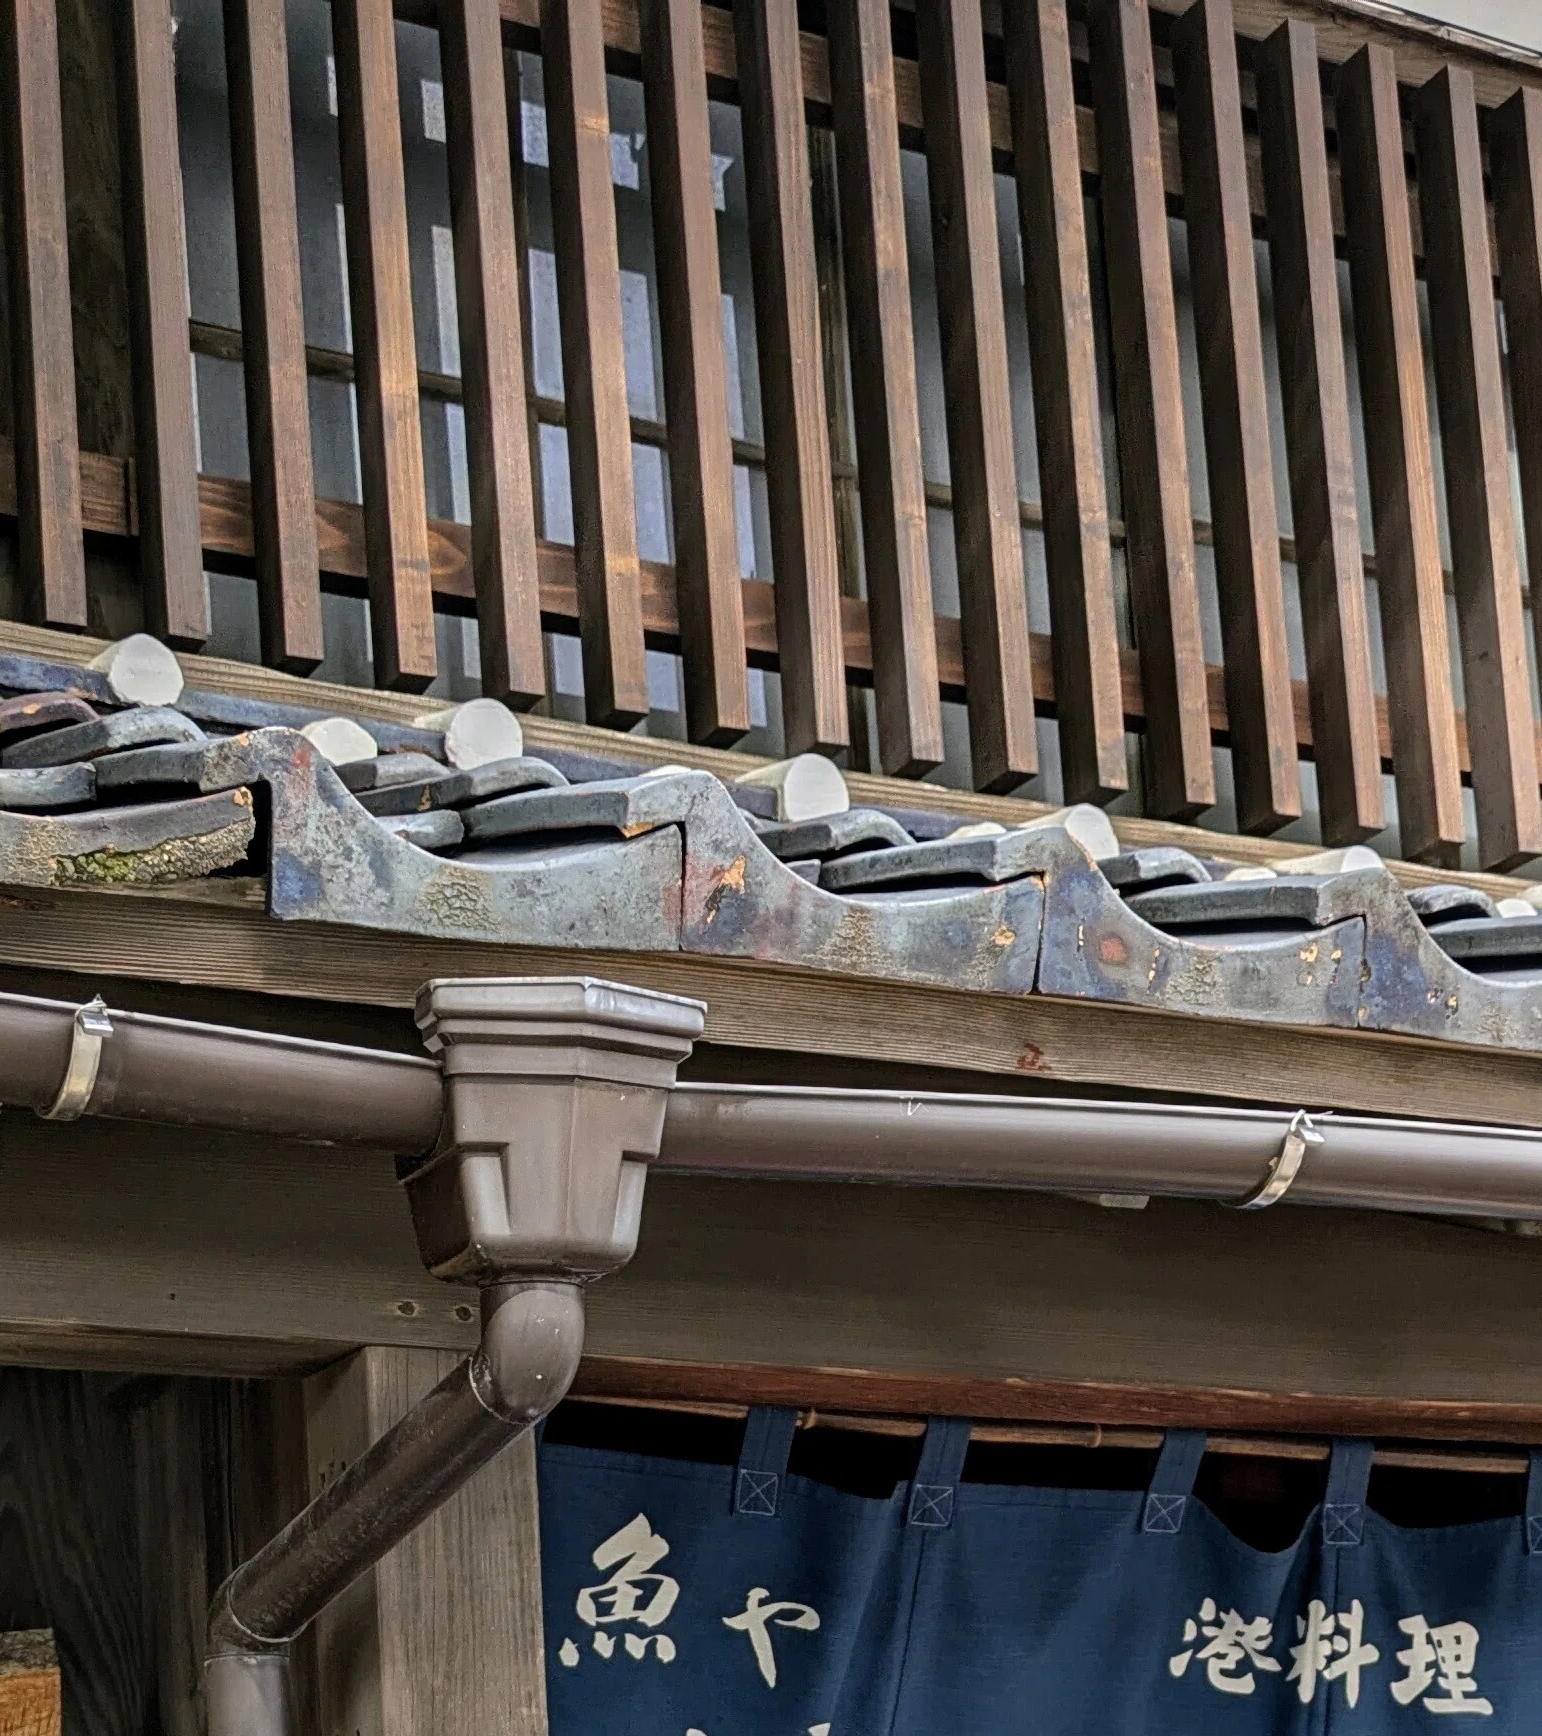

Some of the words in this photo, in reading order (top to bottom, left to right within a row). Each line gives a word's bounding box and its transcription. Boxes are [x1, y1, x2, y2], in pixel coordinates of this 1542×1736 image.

[558, 1511, 821, 1688] 魚や
[1168, 1597, 1495, 1717] 港料理
